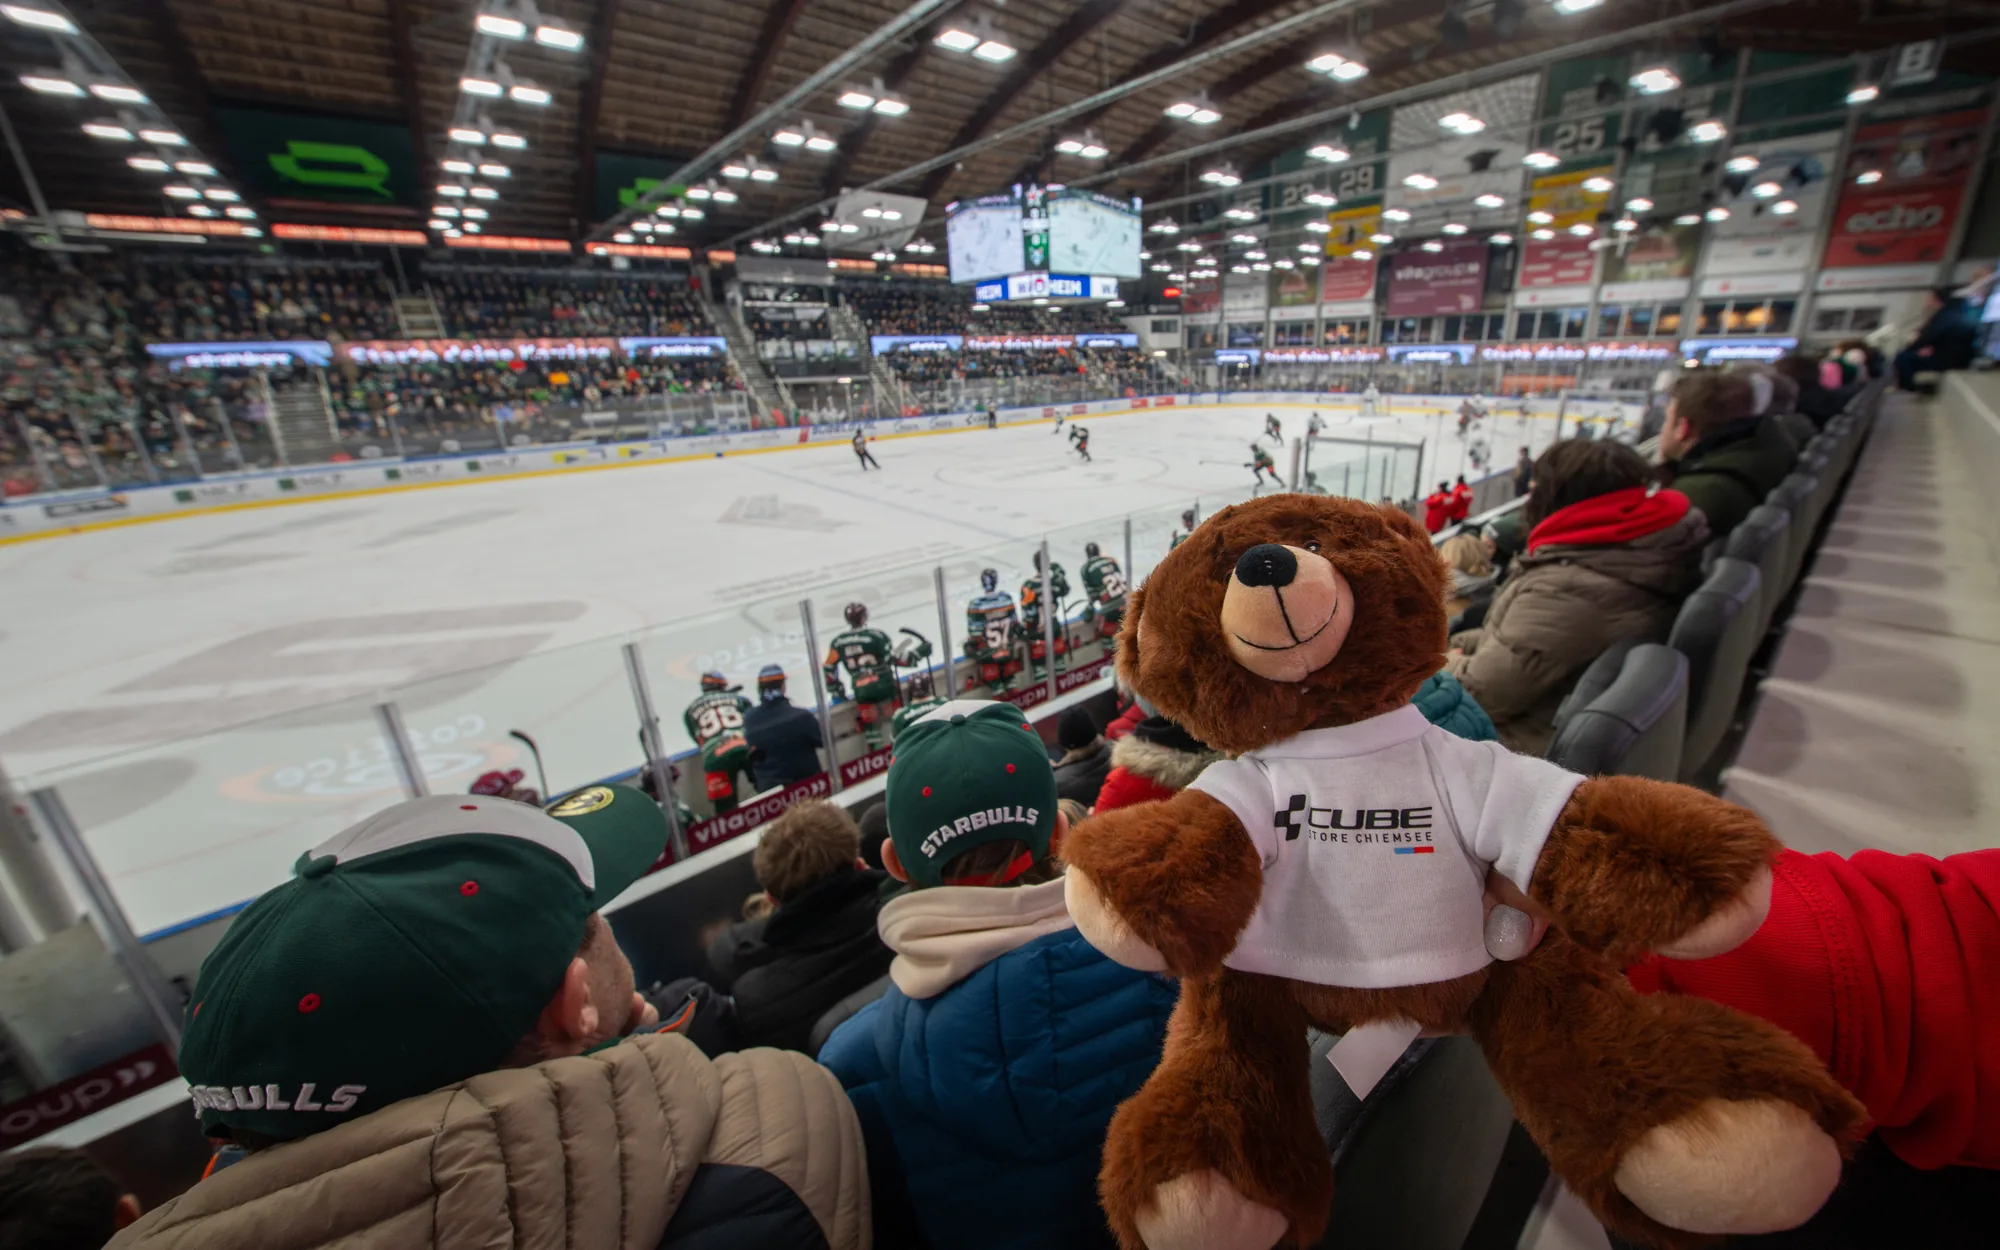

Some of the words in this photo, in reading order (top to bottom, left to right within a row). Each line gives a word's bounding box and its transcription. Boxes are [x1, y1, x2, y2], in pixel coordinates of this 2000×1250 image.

[1553, 116, 1606, 151] 25
[1339, 165, 1375, 198] 29
[986, 618, 1012, 649] 57
[920, 805, 1039, 858] STARBULLS
[1308, 807, 1432, 829] CUBE
[1355, 832, 1433, 843] CHIEMSEE
